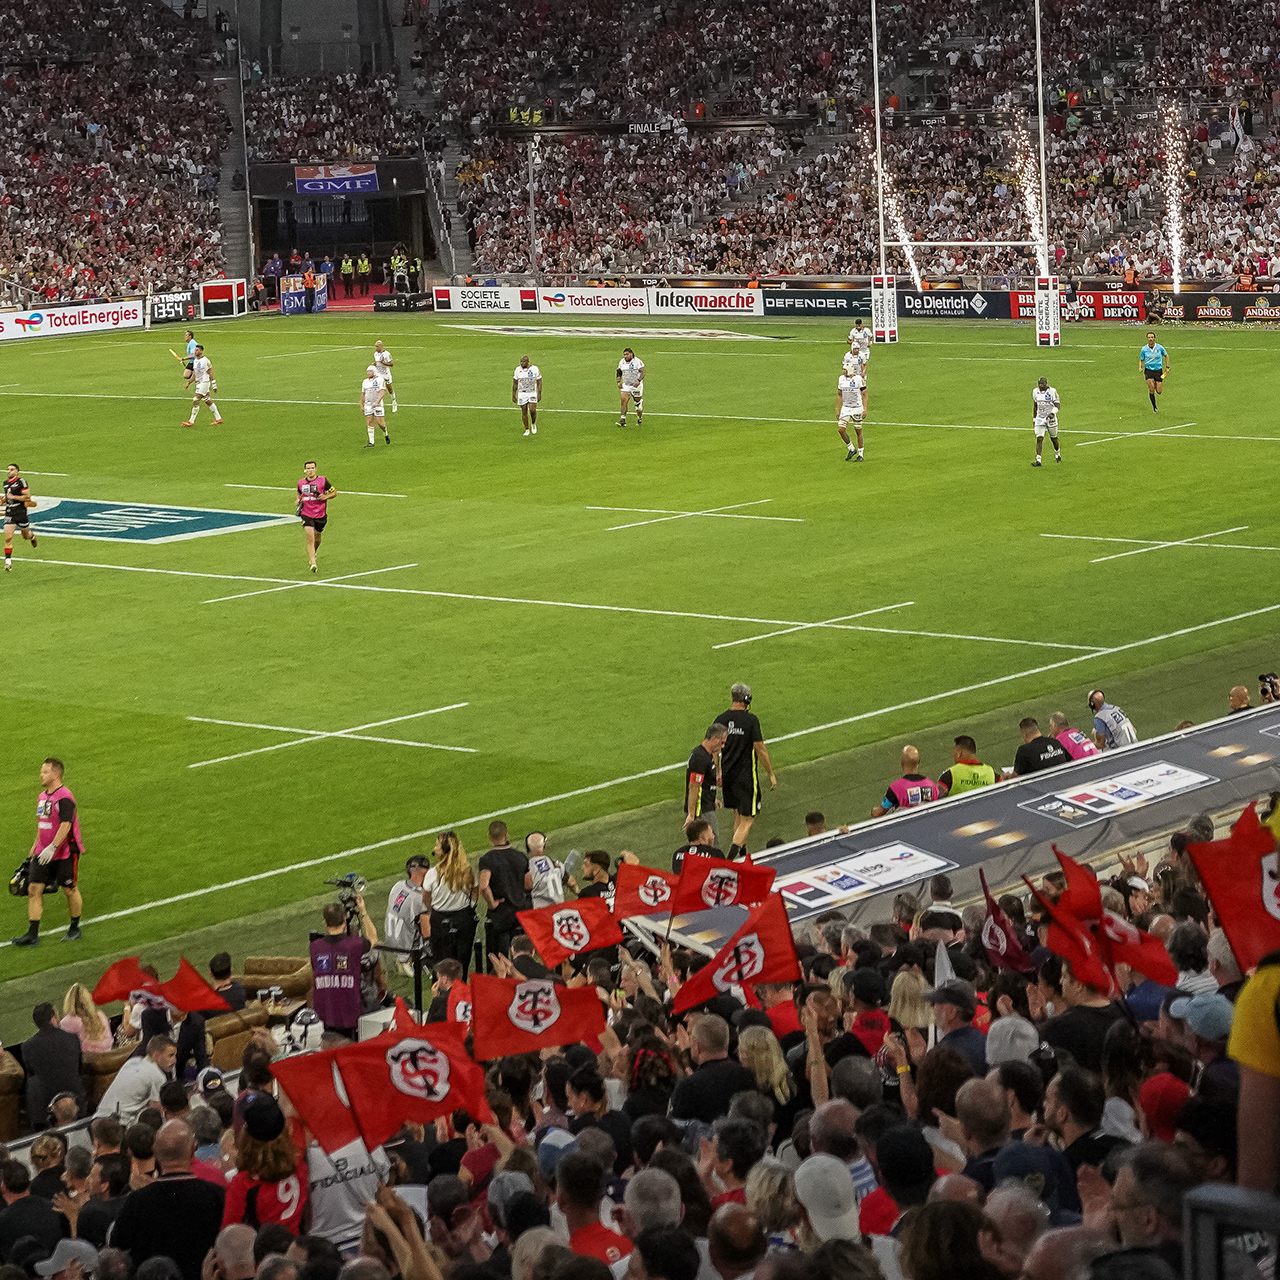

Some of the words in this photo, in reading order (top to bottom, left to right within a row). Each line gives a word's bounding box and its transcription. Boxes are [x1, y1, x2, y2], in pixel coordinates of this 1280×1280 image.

[629, 123, 660, 133] FINALE
[303, 180, 371, 191] GMF
[160, 292, 192, 303] TISSOT
[460, 290, 500, 299] SOCIETE
[1102, 294, 1137, 304] BRICO
[461, 300, 510, 309] GENERALE
[568, 294, 645, 310] TotalEnergies
[765, 298, 848, 308] DEFENDER
[905, 296, 922, 309] De
[923, 295, 969, 309] Dietrich
[1103, 304, 1138, 318] DEPÔT
[1198, 308, 1232, 319] ANDROS
[1245, 308, 1280, 319] ANDROS
[46, 306, 139, 328] TotalEnergies
[277, 1174, 300, 1220] 9
